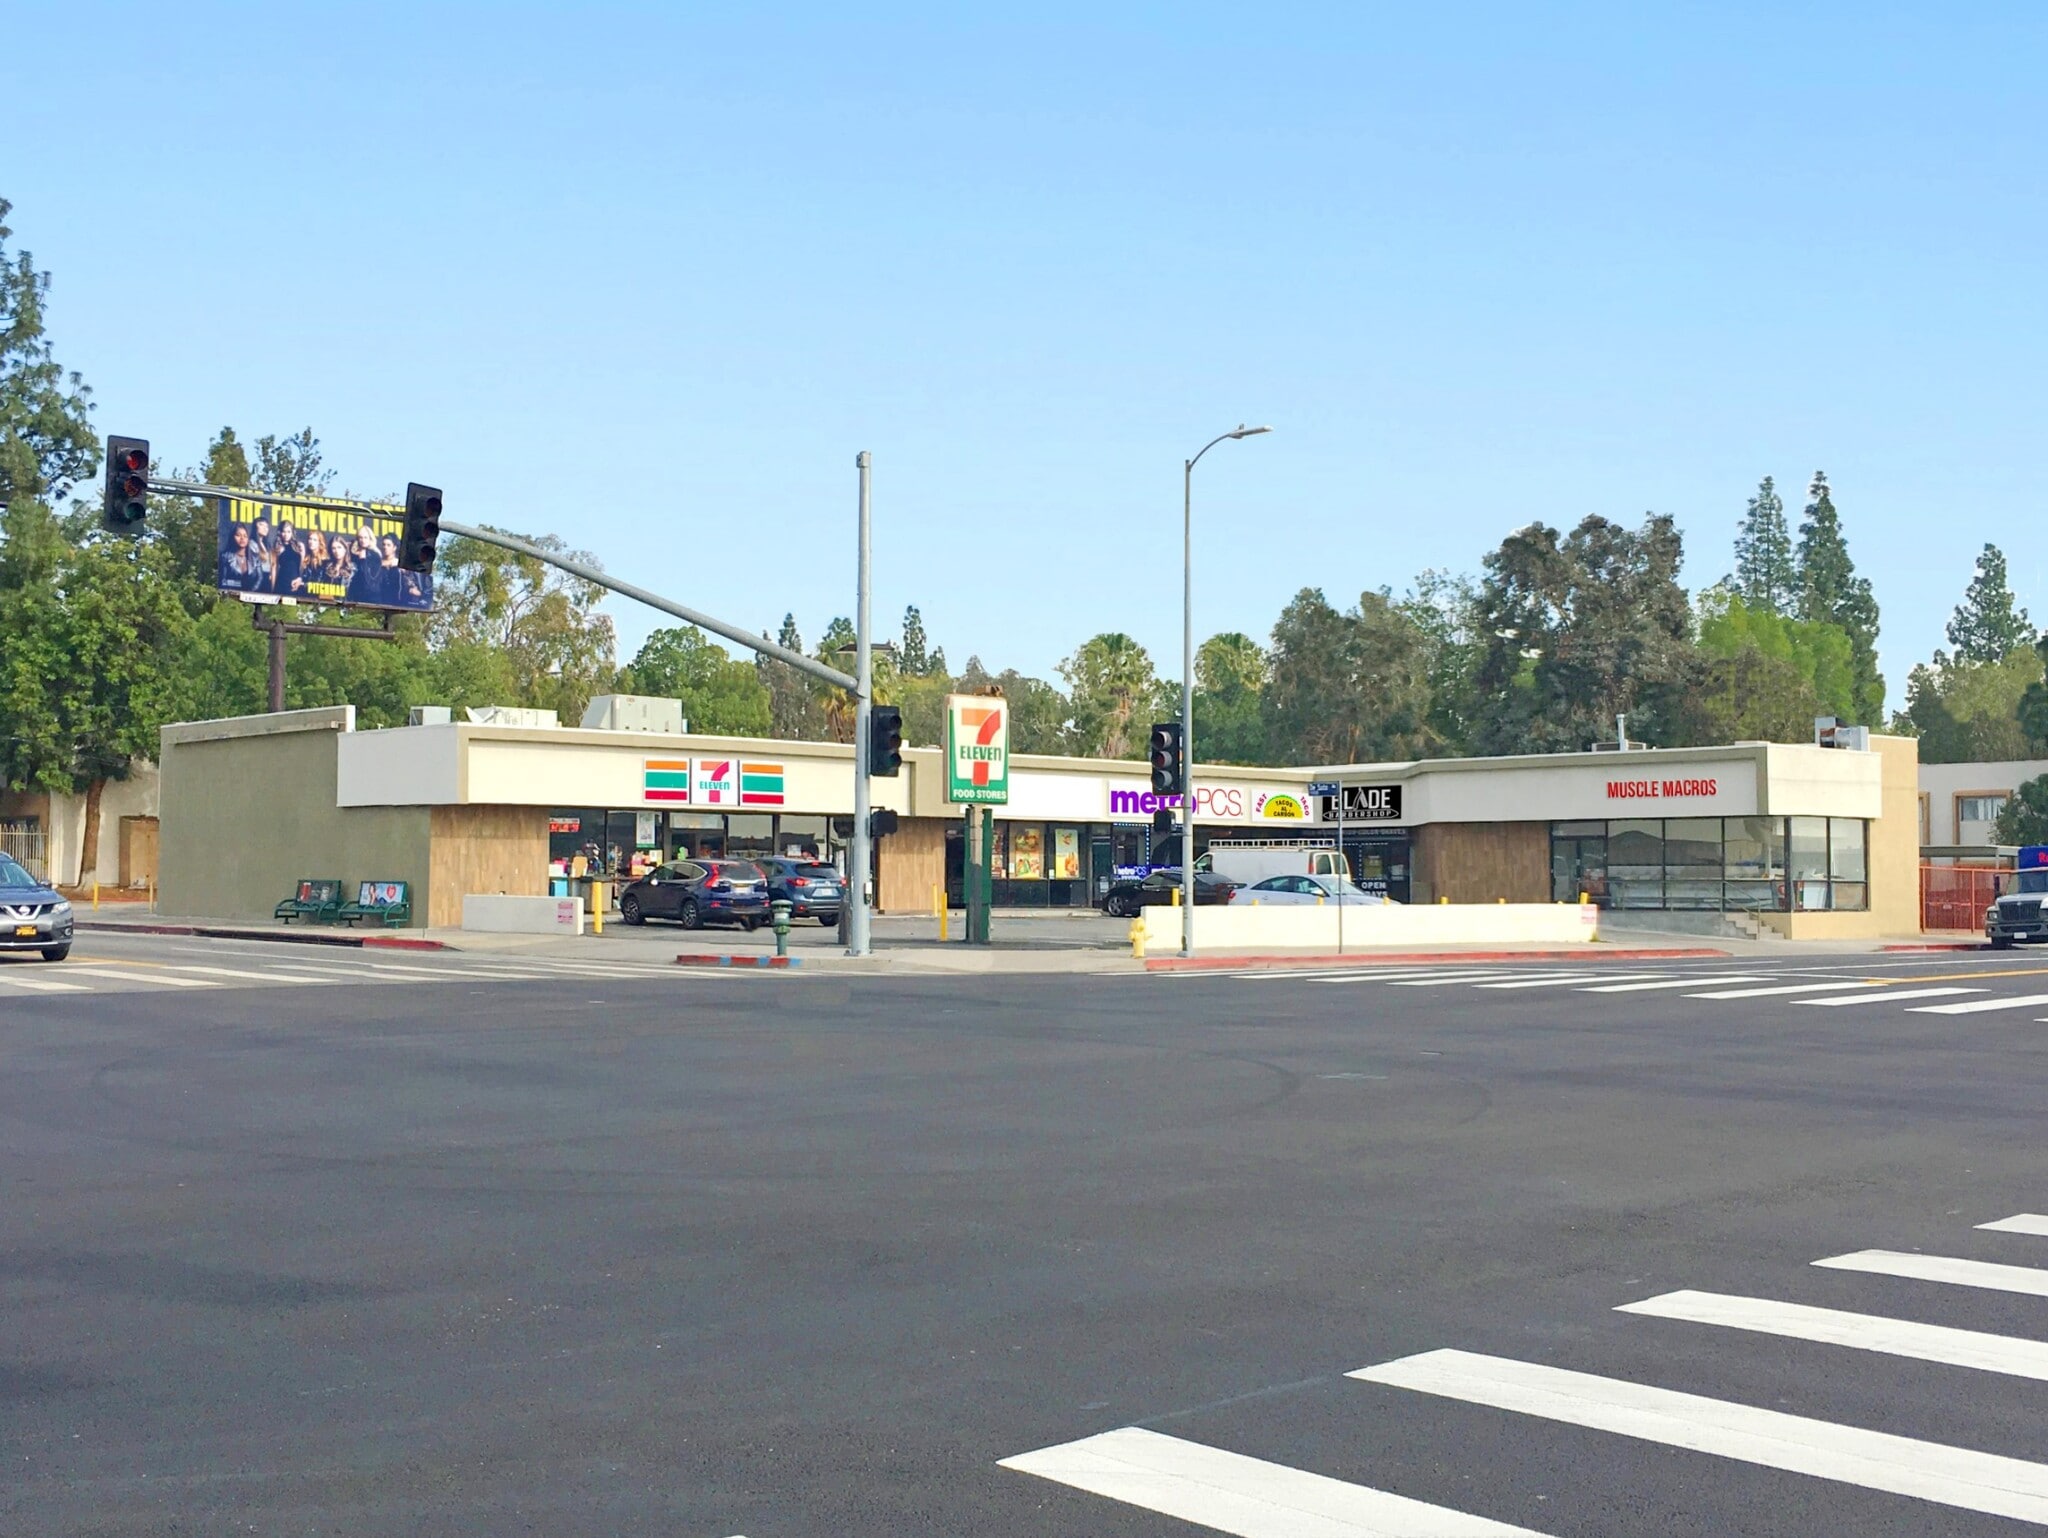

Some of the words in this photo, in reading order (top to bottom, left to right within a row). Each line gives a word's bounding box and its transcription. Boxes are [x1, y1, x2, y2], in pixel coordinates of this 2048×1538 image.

[272, 492, 364, 536] FAREWELL
[961, 708, 1001, 786] 7
[700, 761, 729, 802] 7
[1607, 780, 1659, 798] MUSCLE
[1662, 778, 1717, 797] MACROS
[953, 789, 975, 799] FOOD
[976, 789, 1006, 800] STORES
[1256, 793, 1267, 812] FAST
[1300, 796, 1310, 816] TACO
[1361, 881, 1387, 889] OPEN
